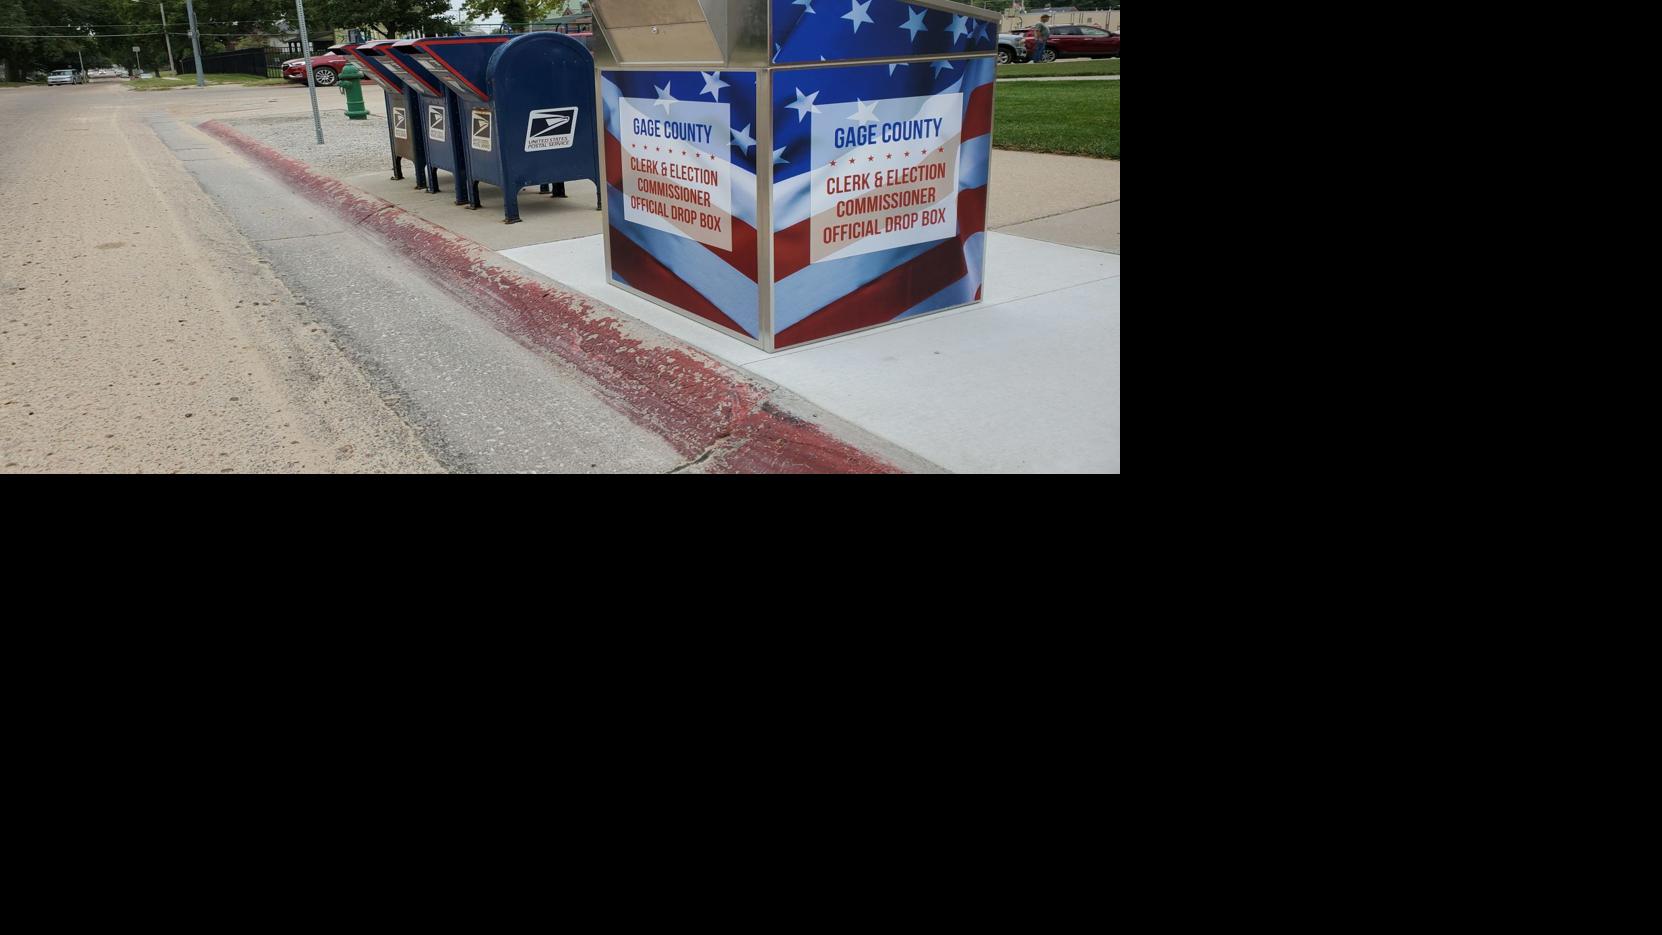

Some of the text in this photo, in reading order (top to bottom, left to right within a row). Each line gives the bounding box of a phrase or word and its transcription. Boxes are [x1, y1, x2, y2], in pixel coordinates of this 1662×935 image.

[633, 118, 712, 144] GAGE COUNTY
[834, 117, 943, 149] GAGE COUNTY
[630, 156, 718, 186] CLERK & ELECTION
[826, 162, 946, 195] CLERK & ELECTION
[637, 177, 711, 208] COMMISSIONER
[836, 187, 936, 218] COMMISSIONER
[630, 196, 722, 232] OFFICIAL DROP BOX
[823, 208, 946, 244] OFFICIAL DROP BOX
